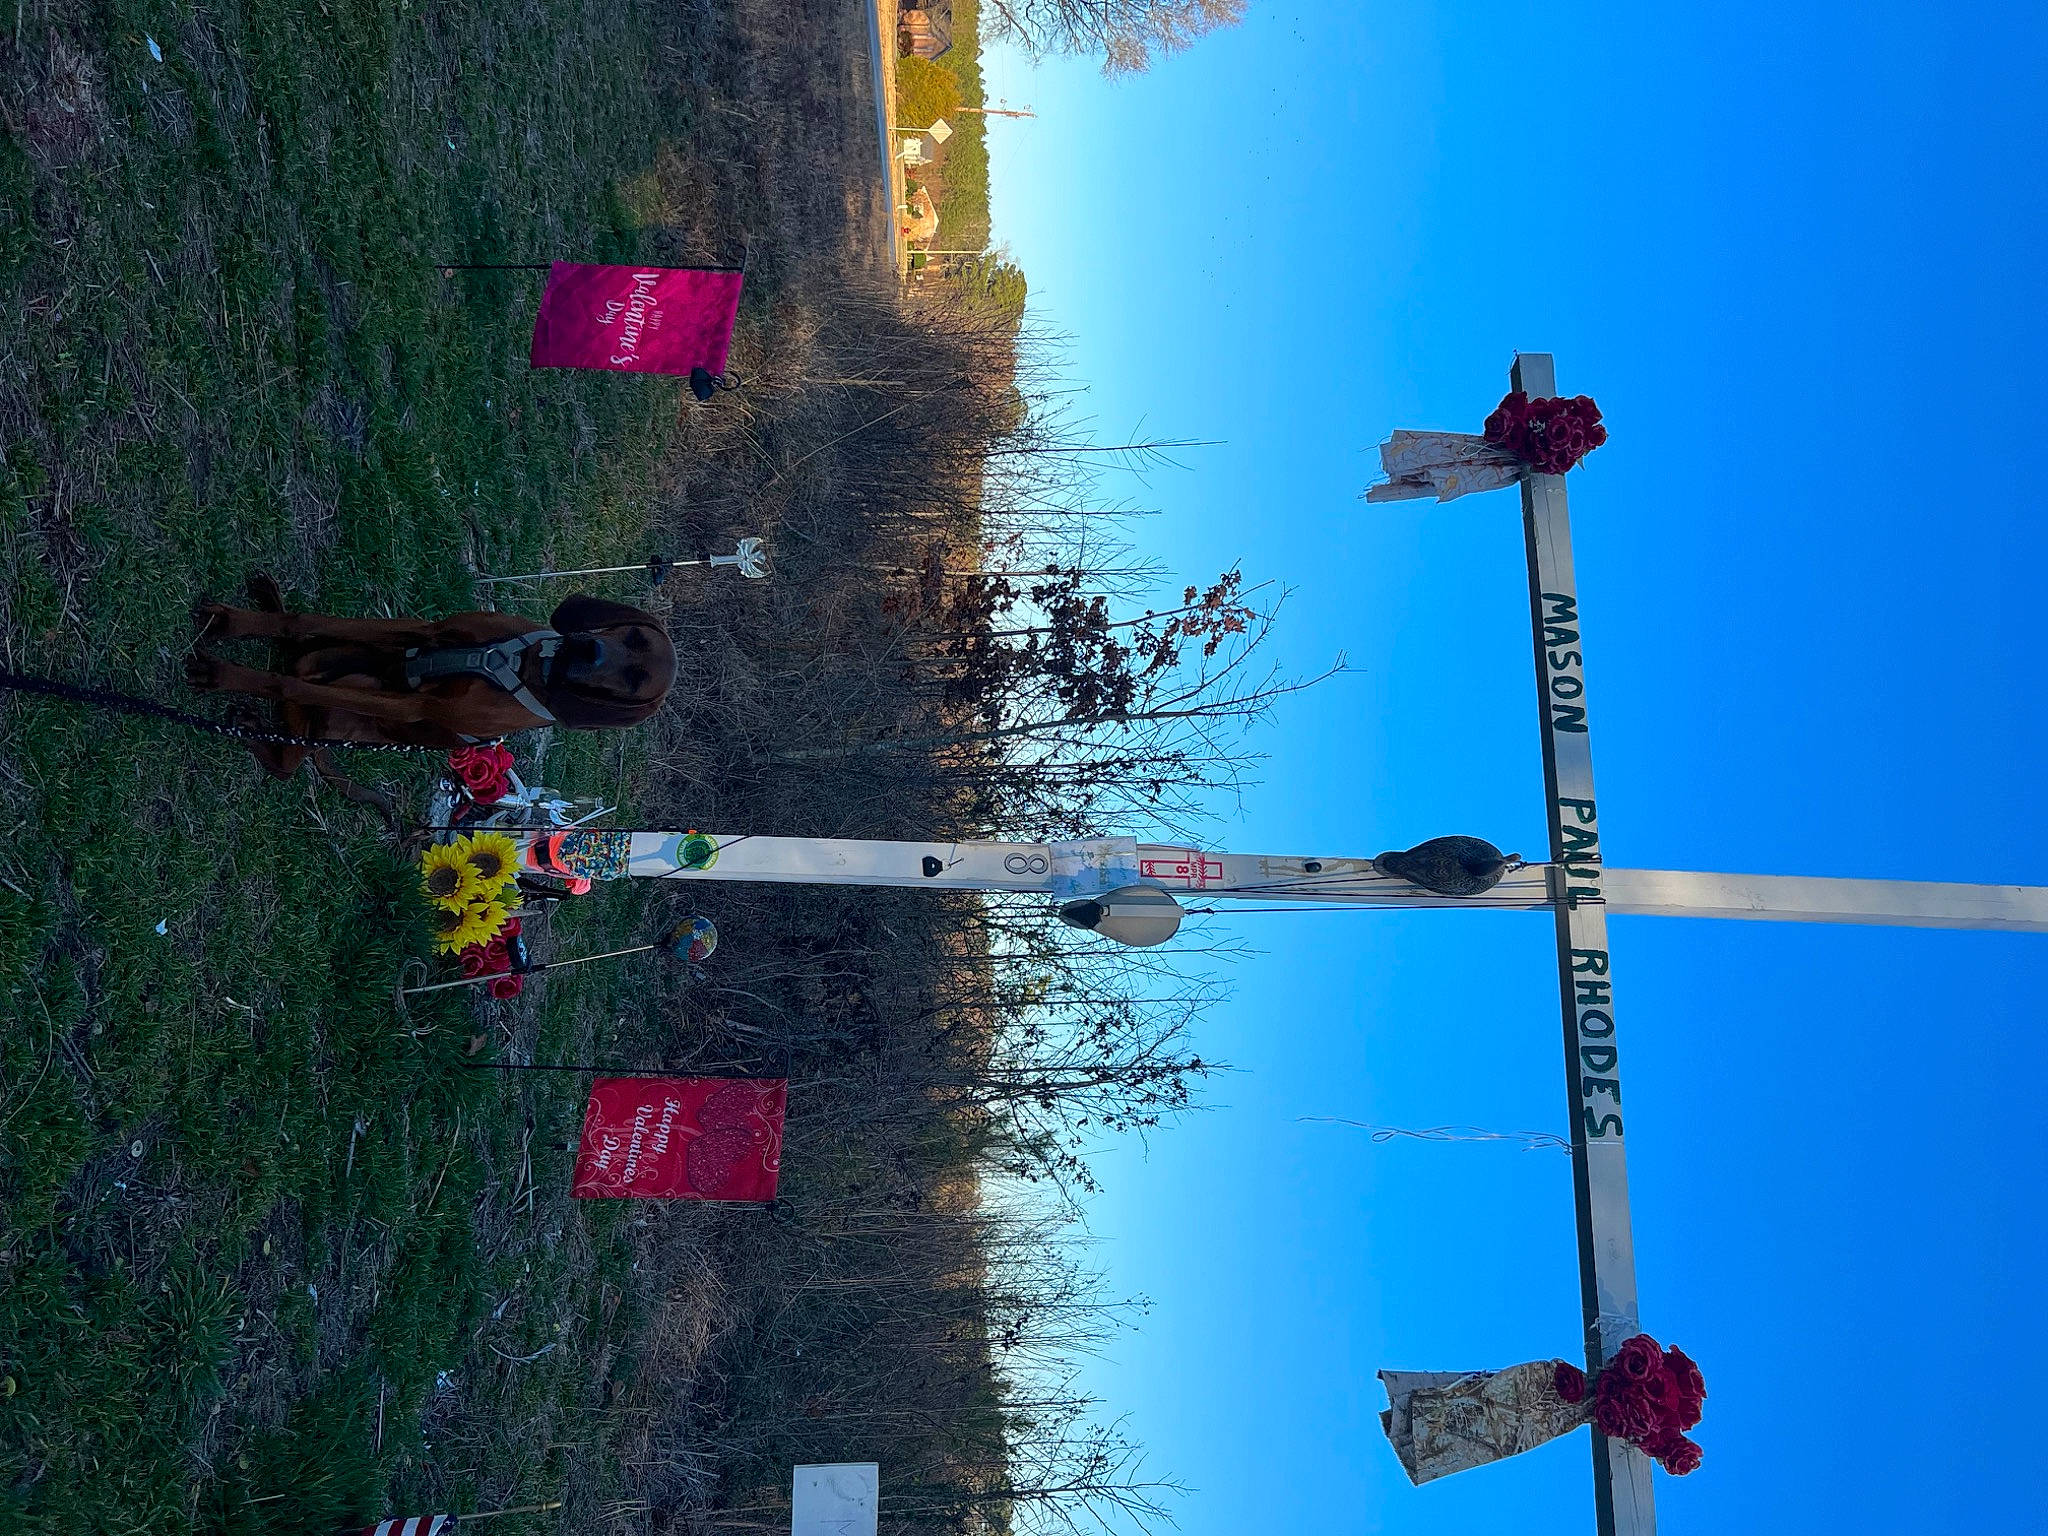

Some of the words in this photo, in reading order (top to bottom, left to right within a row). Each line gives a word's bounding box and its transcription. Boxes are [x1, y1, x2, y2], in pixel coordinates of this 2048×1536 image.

[596, 299, 625, 325] Day
[610, 273, 660, 368] Valentine's
[649, 310, 663, 330] HAPPY
[1541, 592, 1590, 733] MASON
[1004, 852, 1049, 875] 8
[1176, 865, 1189, 874] 8
[1190, 861, 1198, 879] MPR
[1558, 797, 1602, 911] PAUL
[1571, 948, 1624, 1138] RHODES
[622, 1104, 654, 1184] Valentines
[651, 1096, 681, 1154] Happy
[594, 1134, 621, 1170] Day
